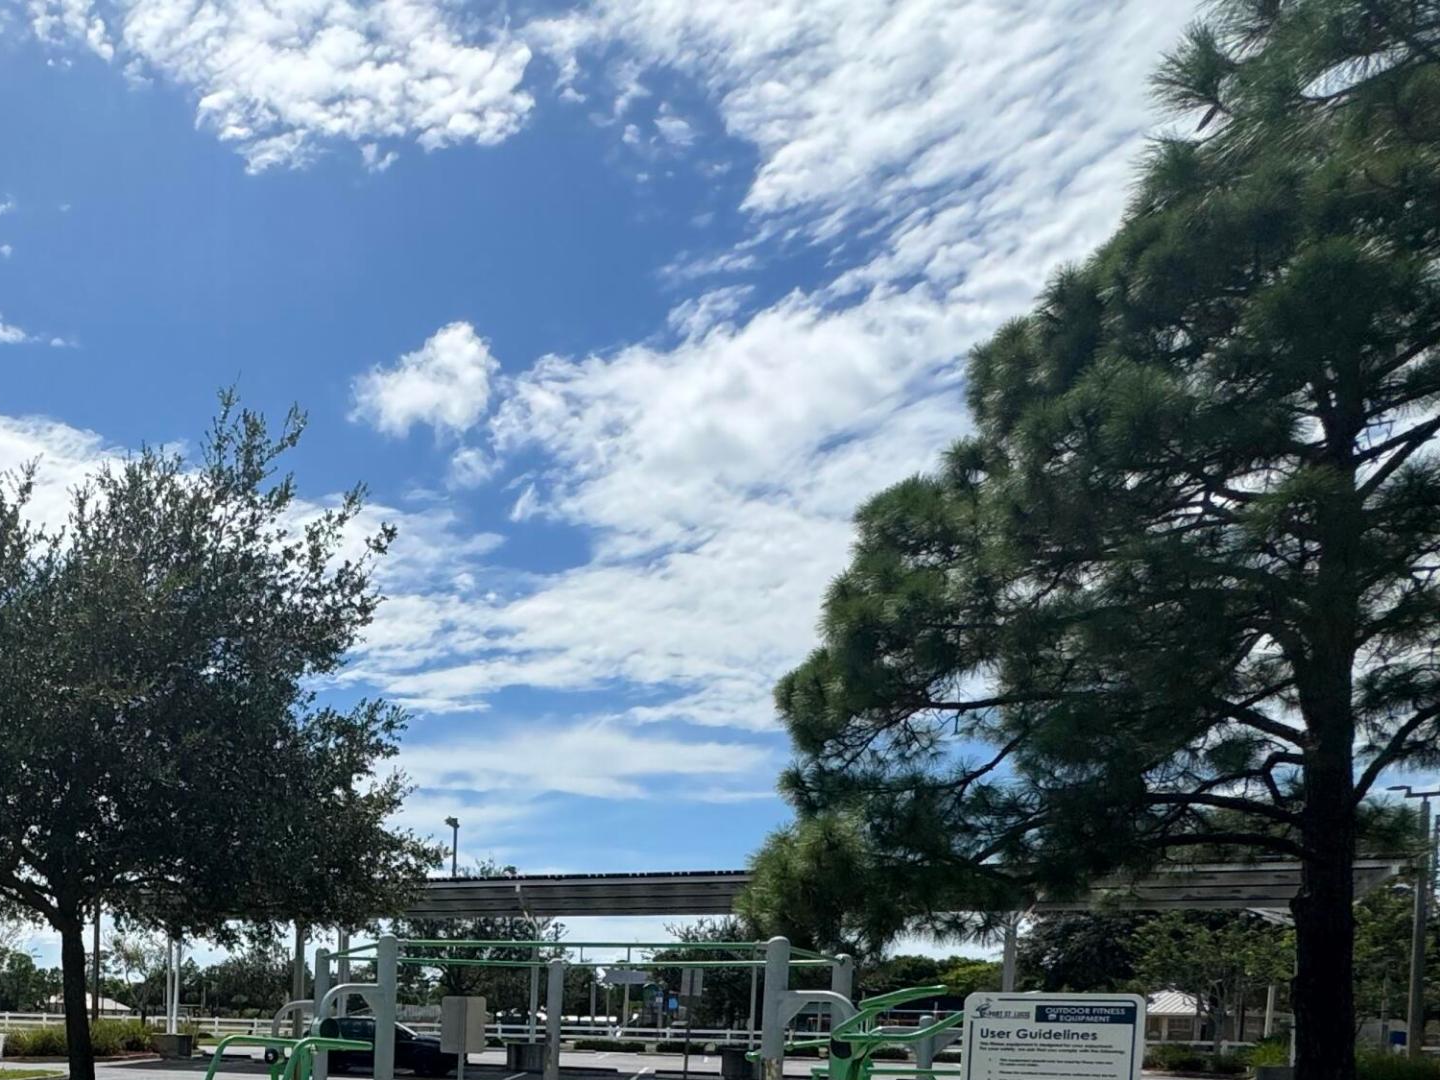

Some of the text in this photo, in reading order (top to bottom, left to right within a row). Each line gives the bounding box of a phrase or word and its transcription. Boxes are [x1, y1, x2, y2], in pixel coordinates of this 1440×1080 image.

[1045, 1007, 1091, 1015] OUTDOOR
[1059, 1015, 1111, 1023] EQUIPMENT
[980, 1028, 1098, 1041] User Guidelines
